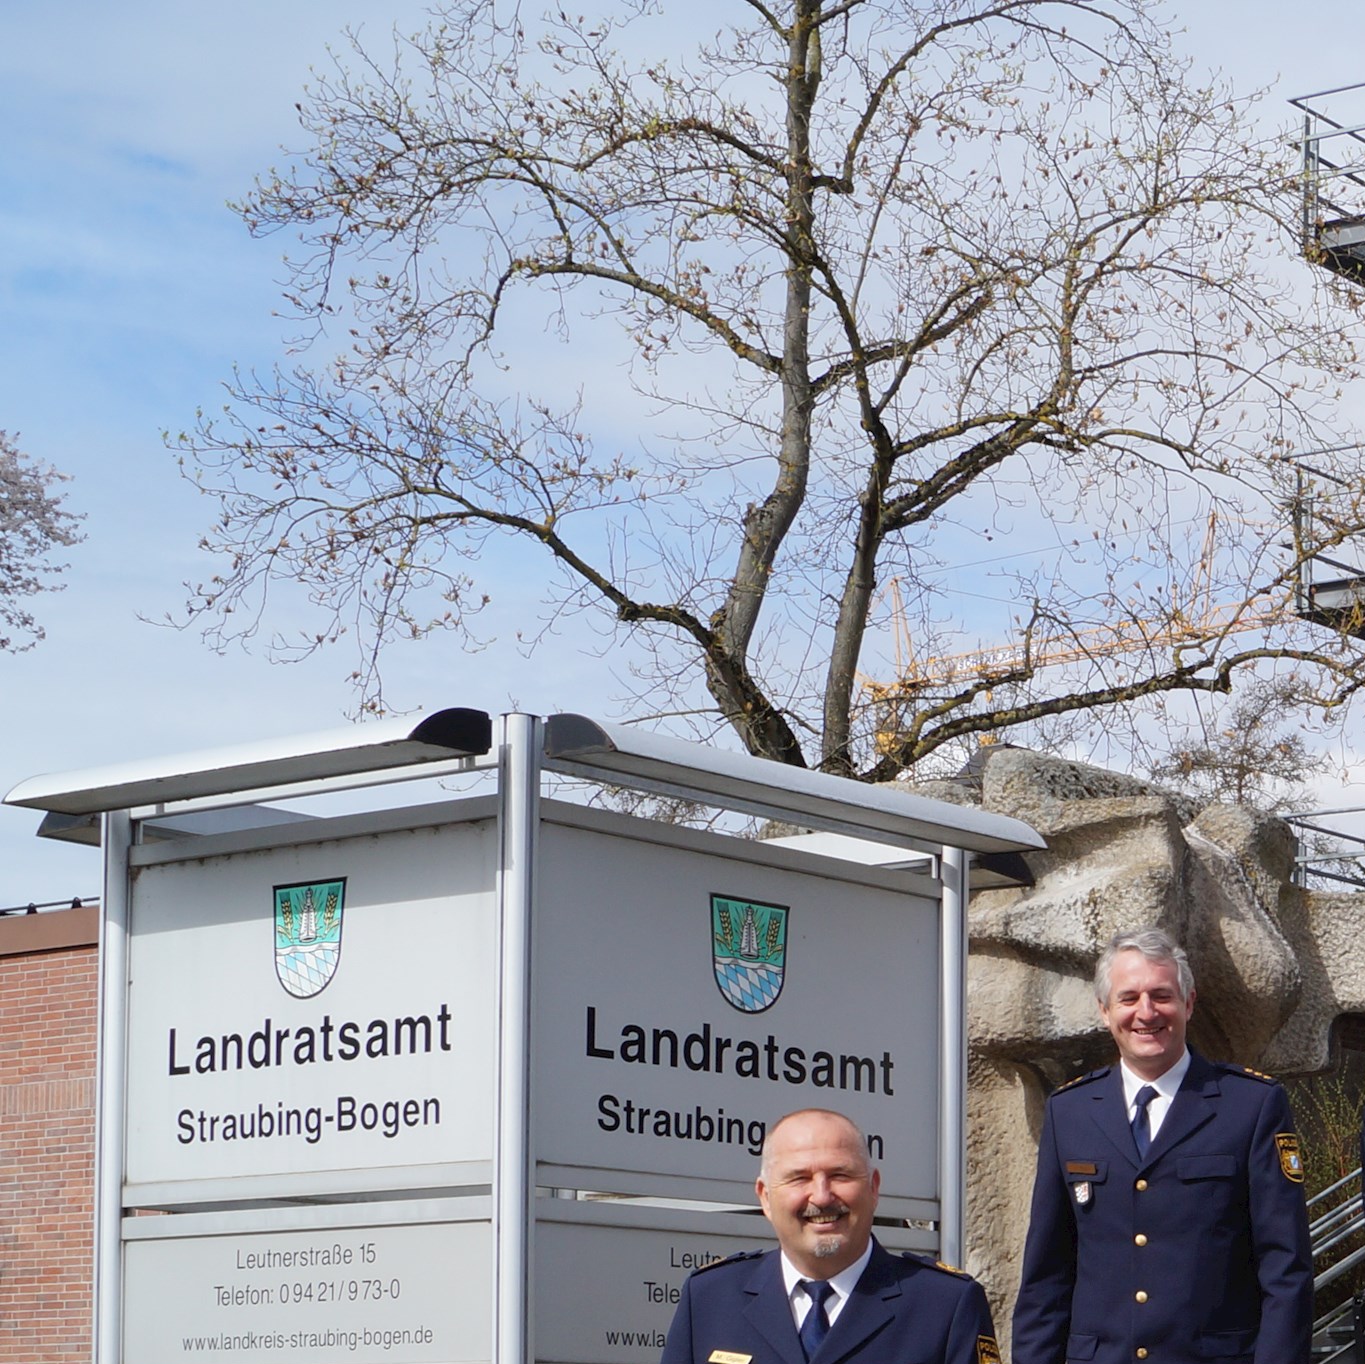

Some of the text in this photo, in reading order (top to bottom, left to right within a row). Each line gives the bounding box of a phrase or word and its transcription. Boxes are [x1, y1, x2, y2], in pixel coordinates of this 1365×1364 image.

[168, 1004, 452, 1076] Landratsamt
[585, 1006, 894, 1096] Landratsamt
[176, 1096, 441, 1144] Straubing-Bogen
[236, 1242, 376, 1270] Leutnerstraße 15
[213, 1284, 274, 1307] Telefon:
[182, 1325, 434, 1352] www.landkreis-straubing-bogen.de
